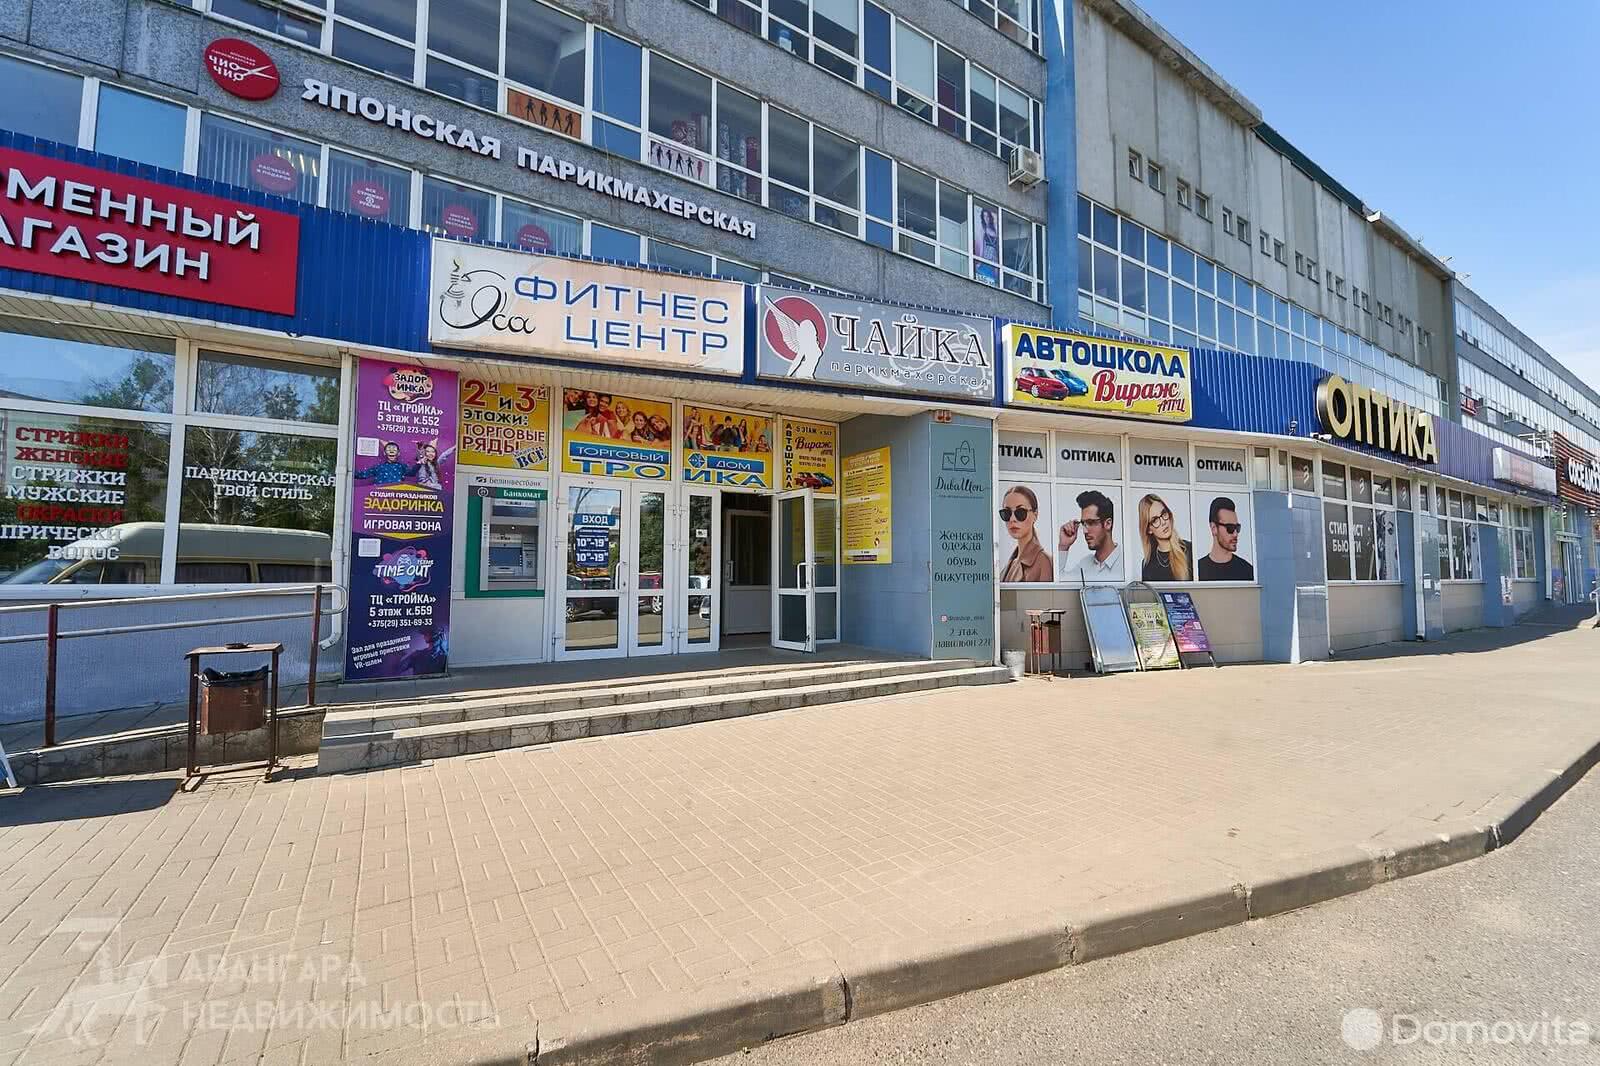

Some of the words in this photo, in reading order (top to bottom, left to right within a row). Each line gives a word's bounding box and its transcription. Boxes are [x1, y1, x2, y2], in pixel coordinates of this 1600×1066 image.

[302, 78, 501, 160] ЯПОНСКАЯ
[517, 146, 757, 240] ПАРИКМАХЕРСКАЯ
[514, 274, 729, 325] ФИТНЕС
[566, 315, 729, 355] ЦЕНТР
[829, 312, 990, 368] ЧАЙКА
[1015, 332, 1186, 379] АВТОШКОЛА
[394, 372, 428, 384] ЗАДОР
[831, 359, 990, 388] парикмахерская
[396, 383, 425, 394] ИНКА
[1092, 367, 1179, 408] Вираж
[377, 400, 391, 413] ТЦ
[393, 402, 444, 416] «ТРОЙКА»
[377, 411, 385, 421] 5
[1319, 374, 1440, 465] ОПТИКА
[15, 426, 129, 449] СТРИЖКИ
[463, 422, 546, 443] ТОРГОВЫЕ
[462, 436, 520, 456] РЯДЫ
[14, 446, 129, 468] ЖЕНСКИЕ
[578, 445, 664, 464] ТОРГОВЫЙ
[715, 460, 751, 471] ДОМ
[1061, 448, 1116, 464] ОПТИКА
[1134, 453, 1184, 469] ОПТИКА
[1196, 458, 1244, 473] ОПТИКА
[11, 465, 127, 487] СТРИЖКИ
[185, 466, 337, 487] ПАРИКМАХЕРСКАЯ
[5, 484, 126, 505] МУЖСКИЕ
[213, 481, 257, 499] ТВОЙ
[261, 485, 314, 500] СТИЛЬ
[364, 497, 444, 513] ЗАДОРИНКА
[363, 519, 413, 531] ИГРОВАЯ
[414, 520, 442, 532] ЗОНА
[581, 514, 609, 526] ВХОД
[0, 524, 125, 541] ПРИЧЕСКИ
[939, 529, 985, 542] Женская
[47, 544, 121, 561] ВОЛОС
[941, 541, 982, 552] одежда
[946, 556, 977, 568] обувь
[375, 564, 406, 578] TIME
[406, 564, 432, 578] OUT
[934, 571, 991, 584] бижутерия
[370, 594, 384, 606] ТЦ
[385, 592, 437, 605] «ТРОЙКА»
[369, 606, 376, 617] 5
